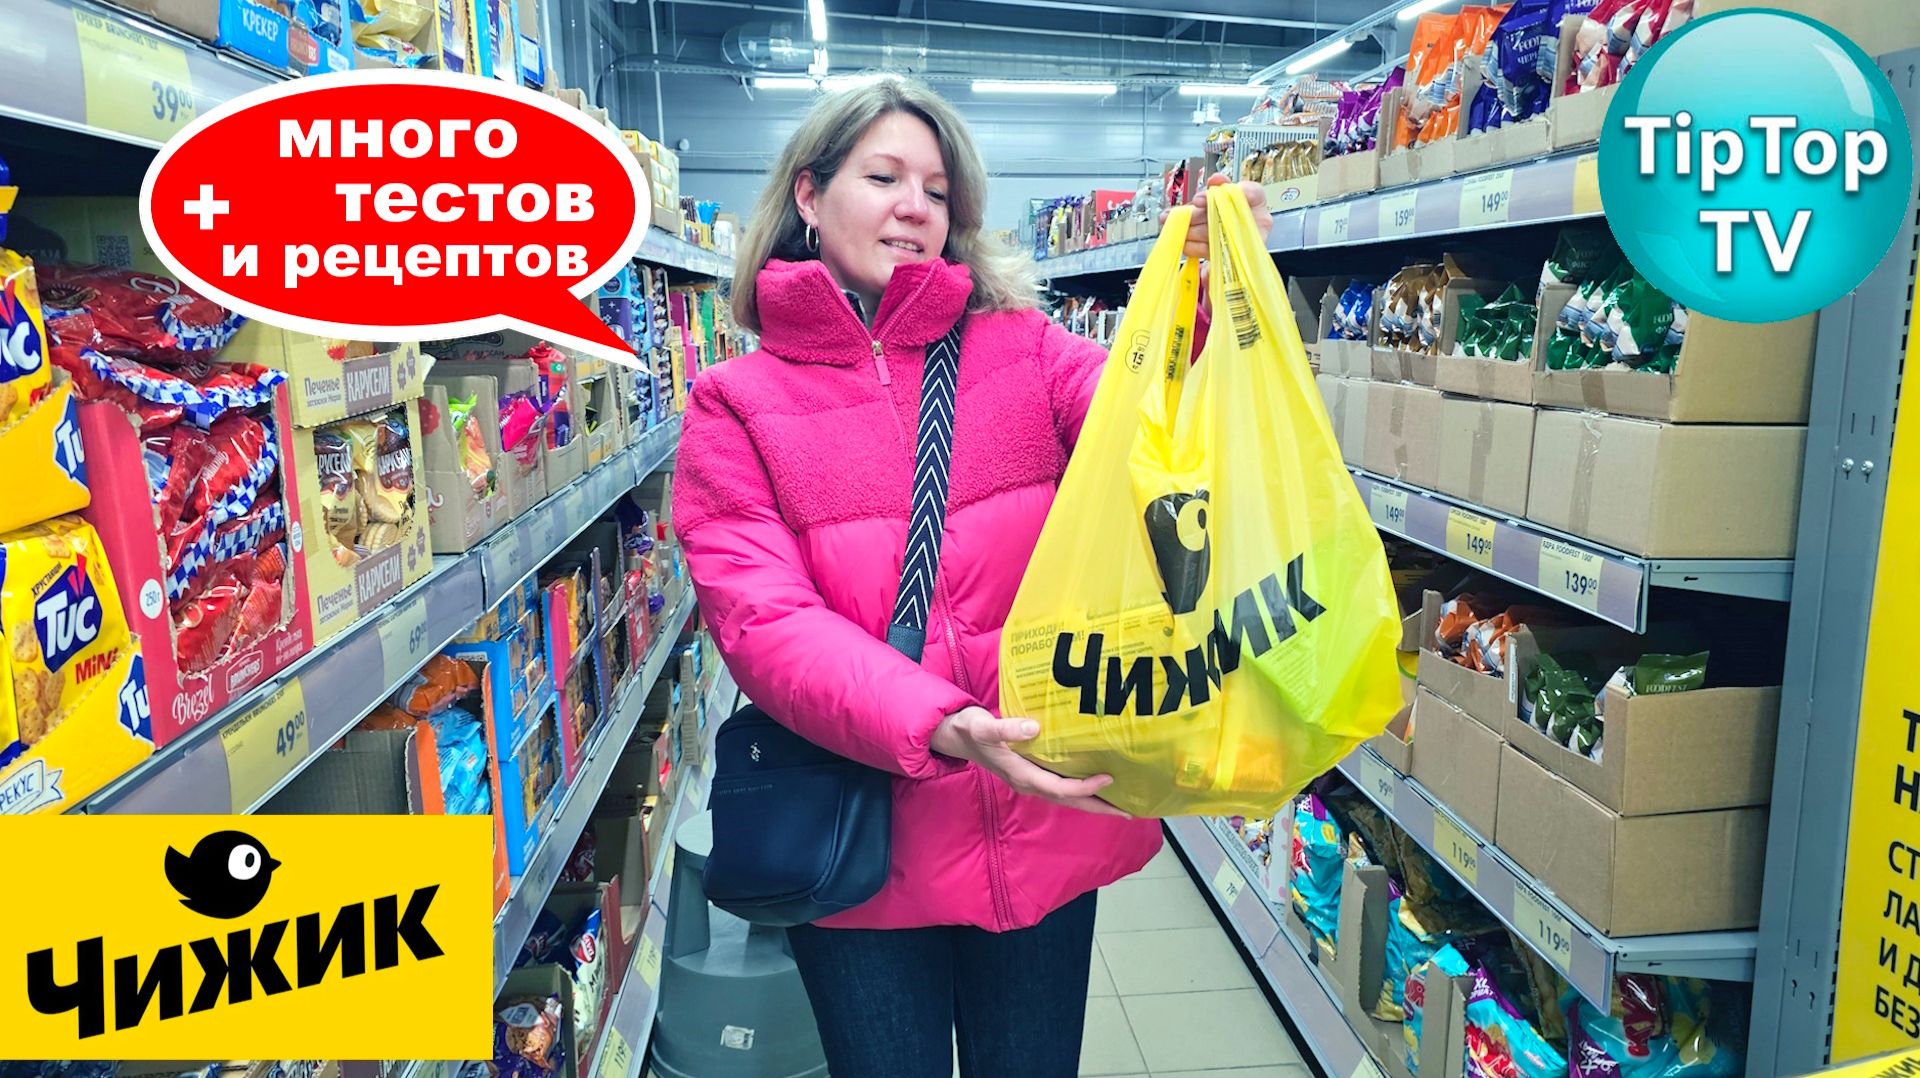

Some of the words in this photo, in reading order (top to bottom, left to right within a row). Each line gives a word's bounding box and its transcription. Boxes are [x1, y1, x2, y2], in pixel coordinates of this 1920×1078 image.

[242, 8, 278, 42] КРЕКЕР
[304, 378, 341, 397] Печенье
[346, 366, 390, 402] КАРУСЕЛИ
[318, 584, 352, 614] Печенье
[358, 554, 401, 604] КАРУСЕЛИ
[37, 590, 97, 658] TUC
[172, 674, 214, 725] Brezel
[1875, 985, 1920, 1039] БЕЗ
